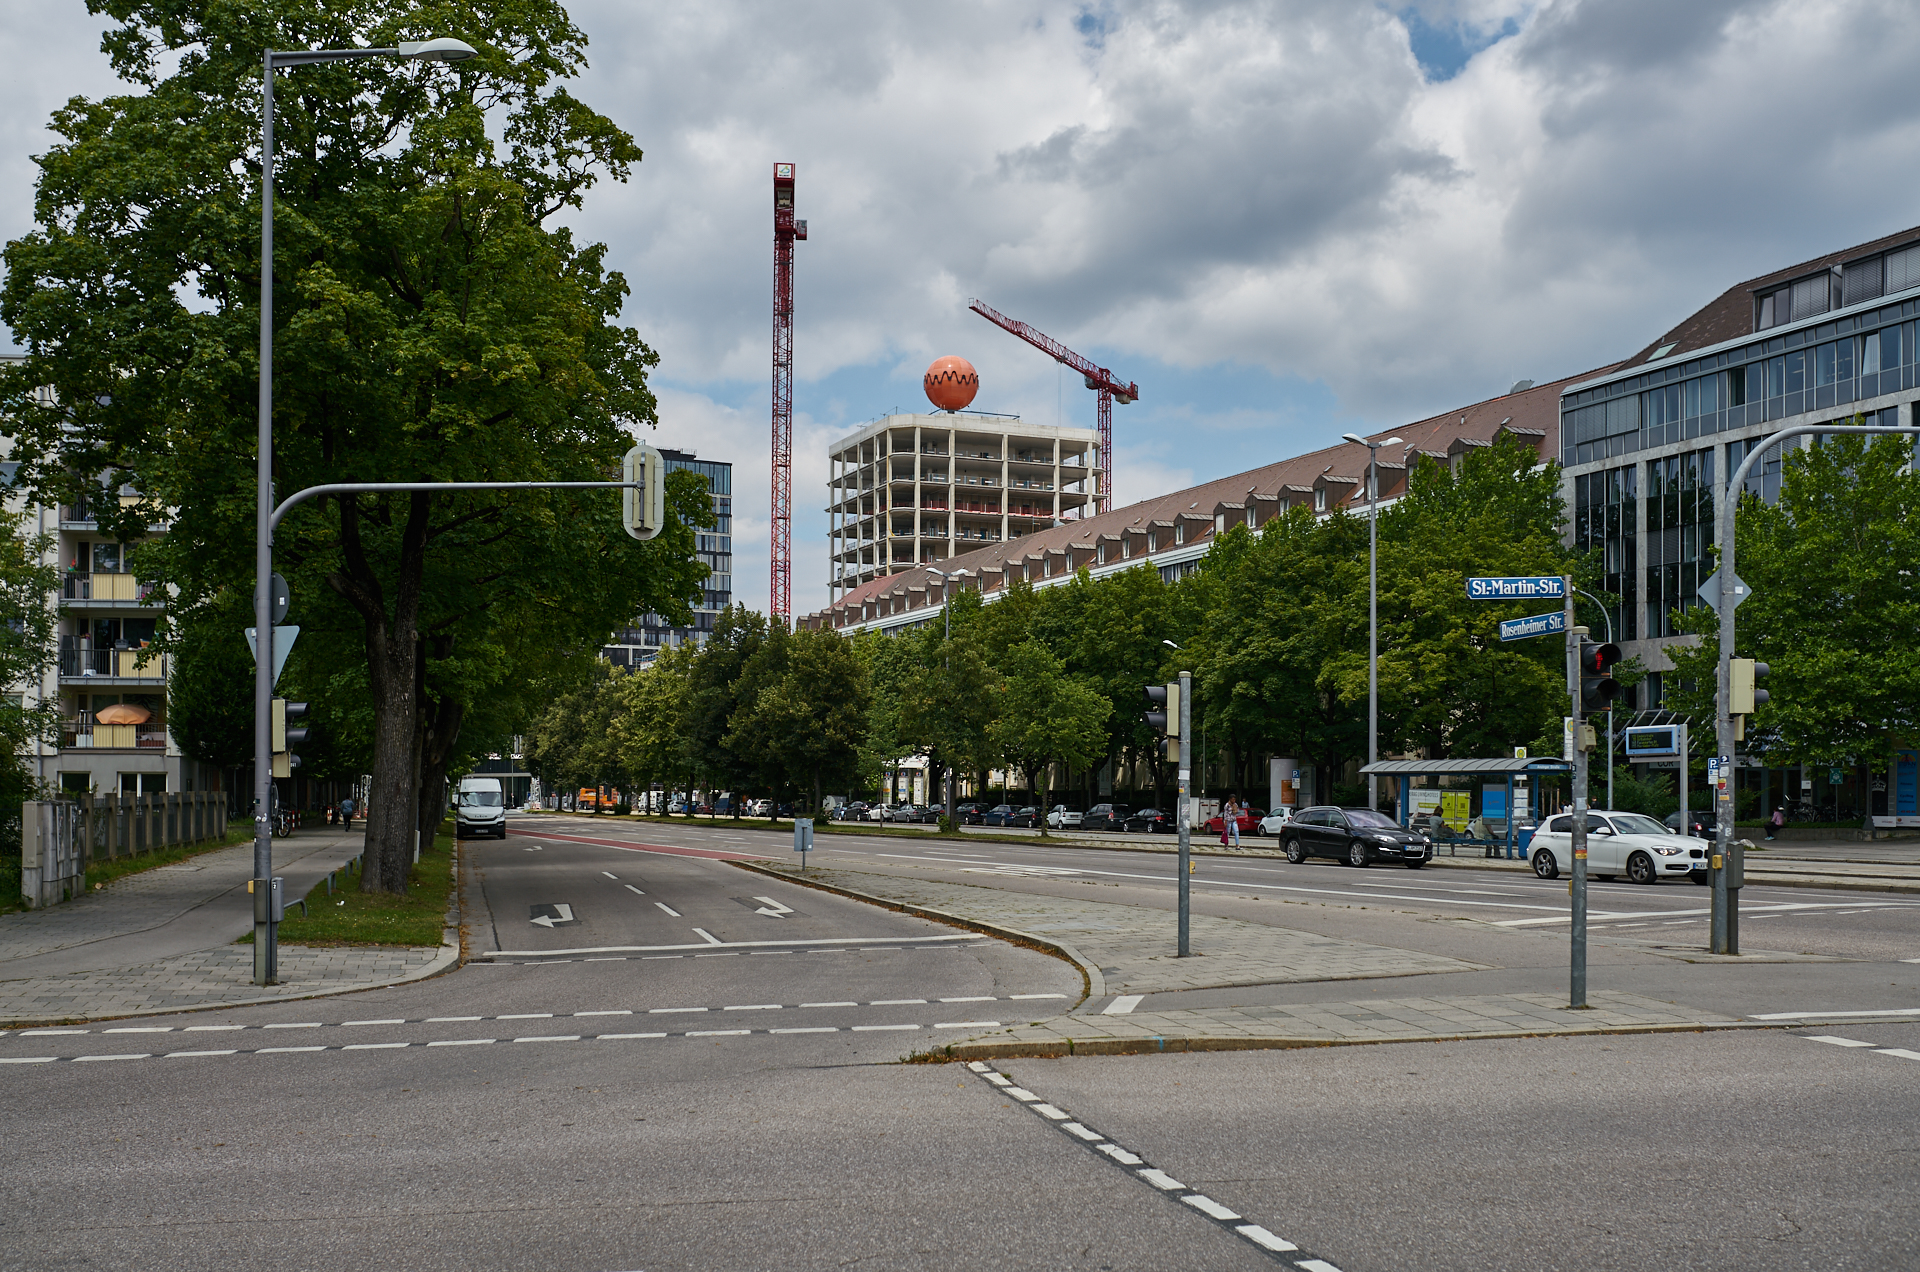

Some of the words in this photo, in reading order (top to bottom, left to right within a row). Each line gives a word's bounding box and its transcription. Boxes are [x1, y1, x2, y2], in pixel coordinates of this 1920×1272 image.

[1472, 579, 1562, 595] St.-Martin-Str.
[1501, 619, 1547, 638] Rosenheimer
[1548, 615, 1563, 630] Str.
